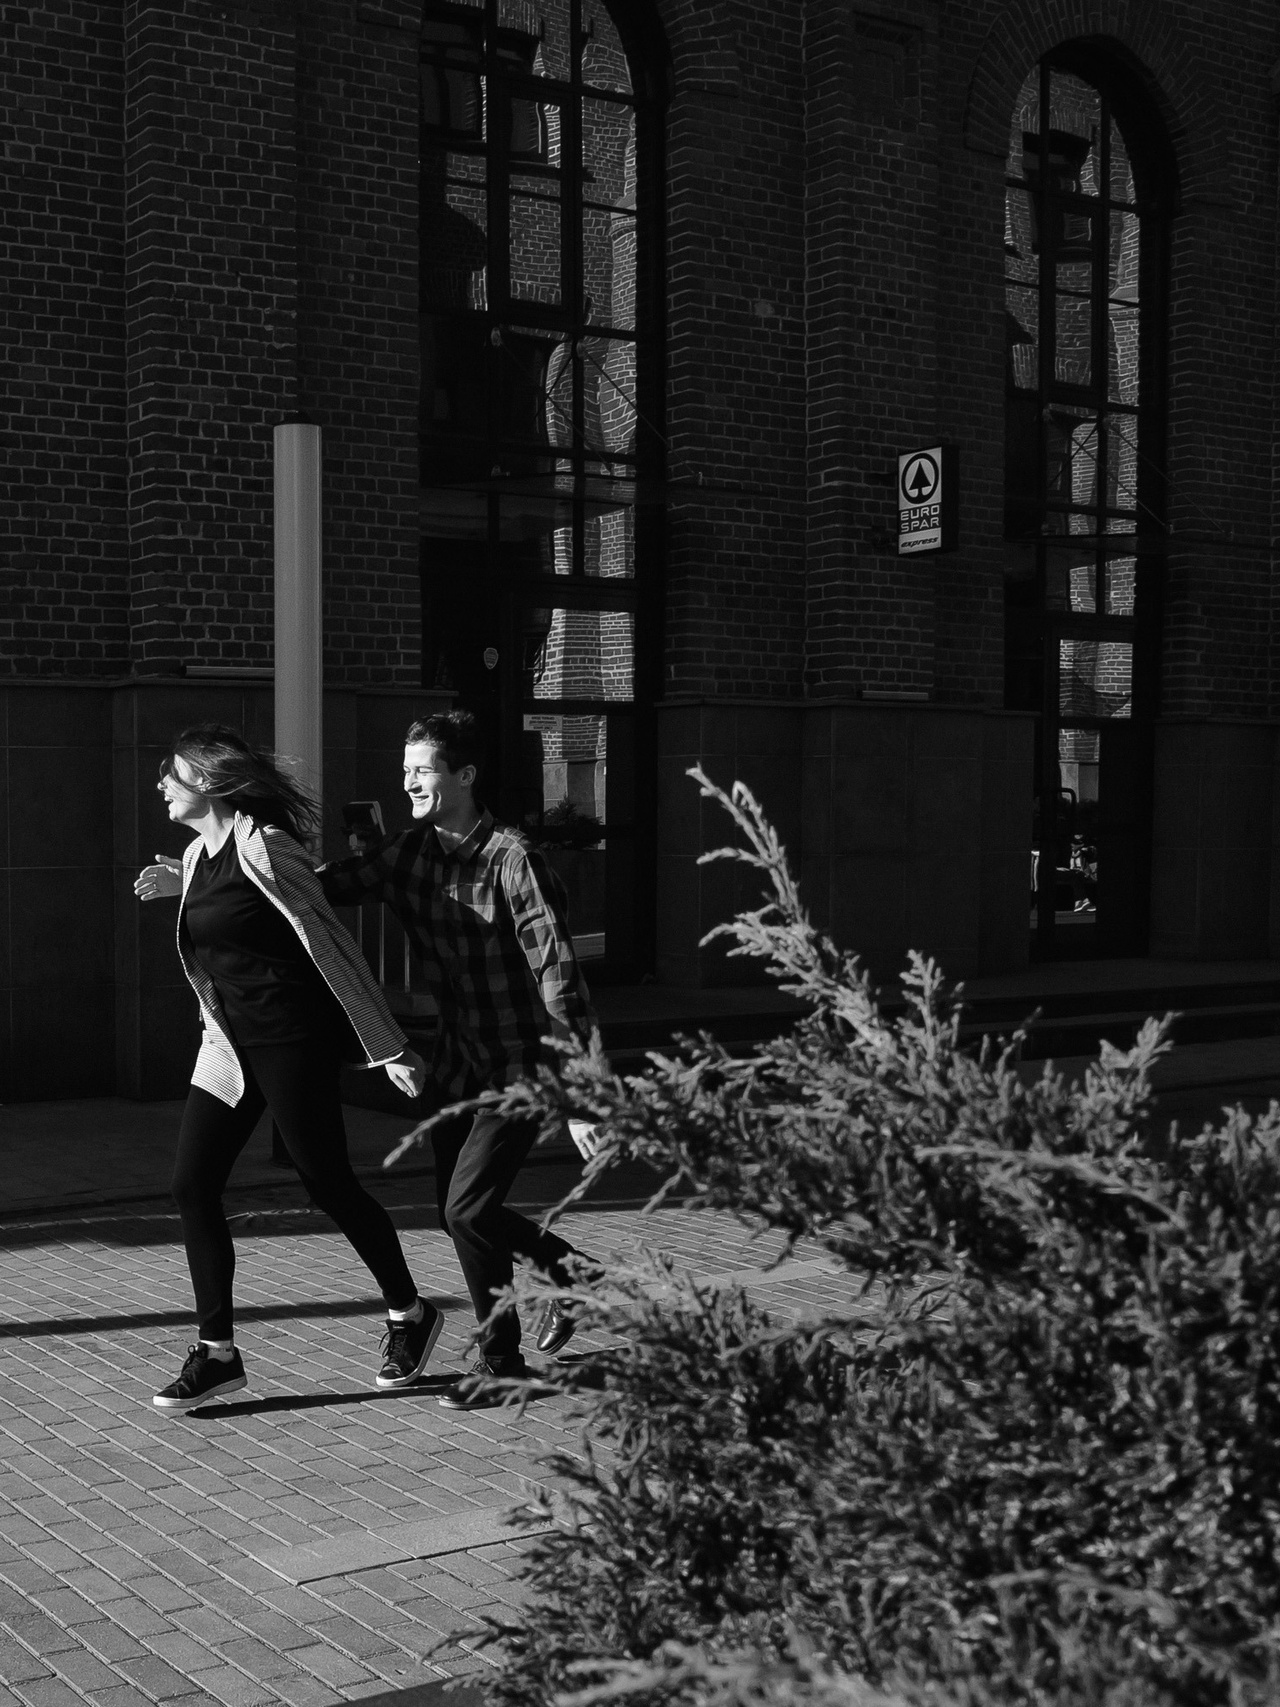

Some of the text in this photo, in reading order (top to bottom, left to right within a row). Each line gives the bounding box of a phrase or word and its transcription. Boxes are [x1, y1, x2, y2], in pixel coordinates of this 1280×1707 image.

[900, 504, 940, 521] EURO
[900, 517, 940, 533] SPAR
[901, 537, 938, 548] express
